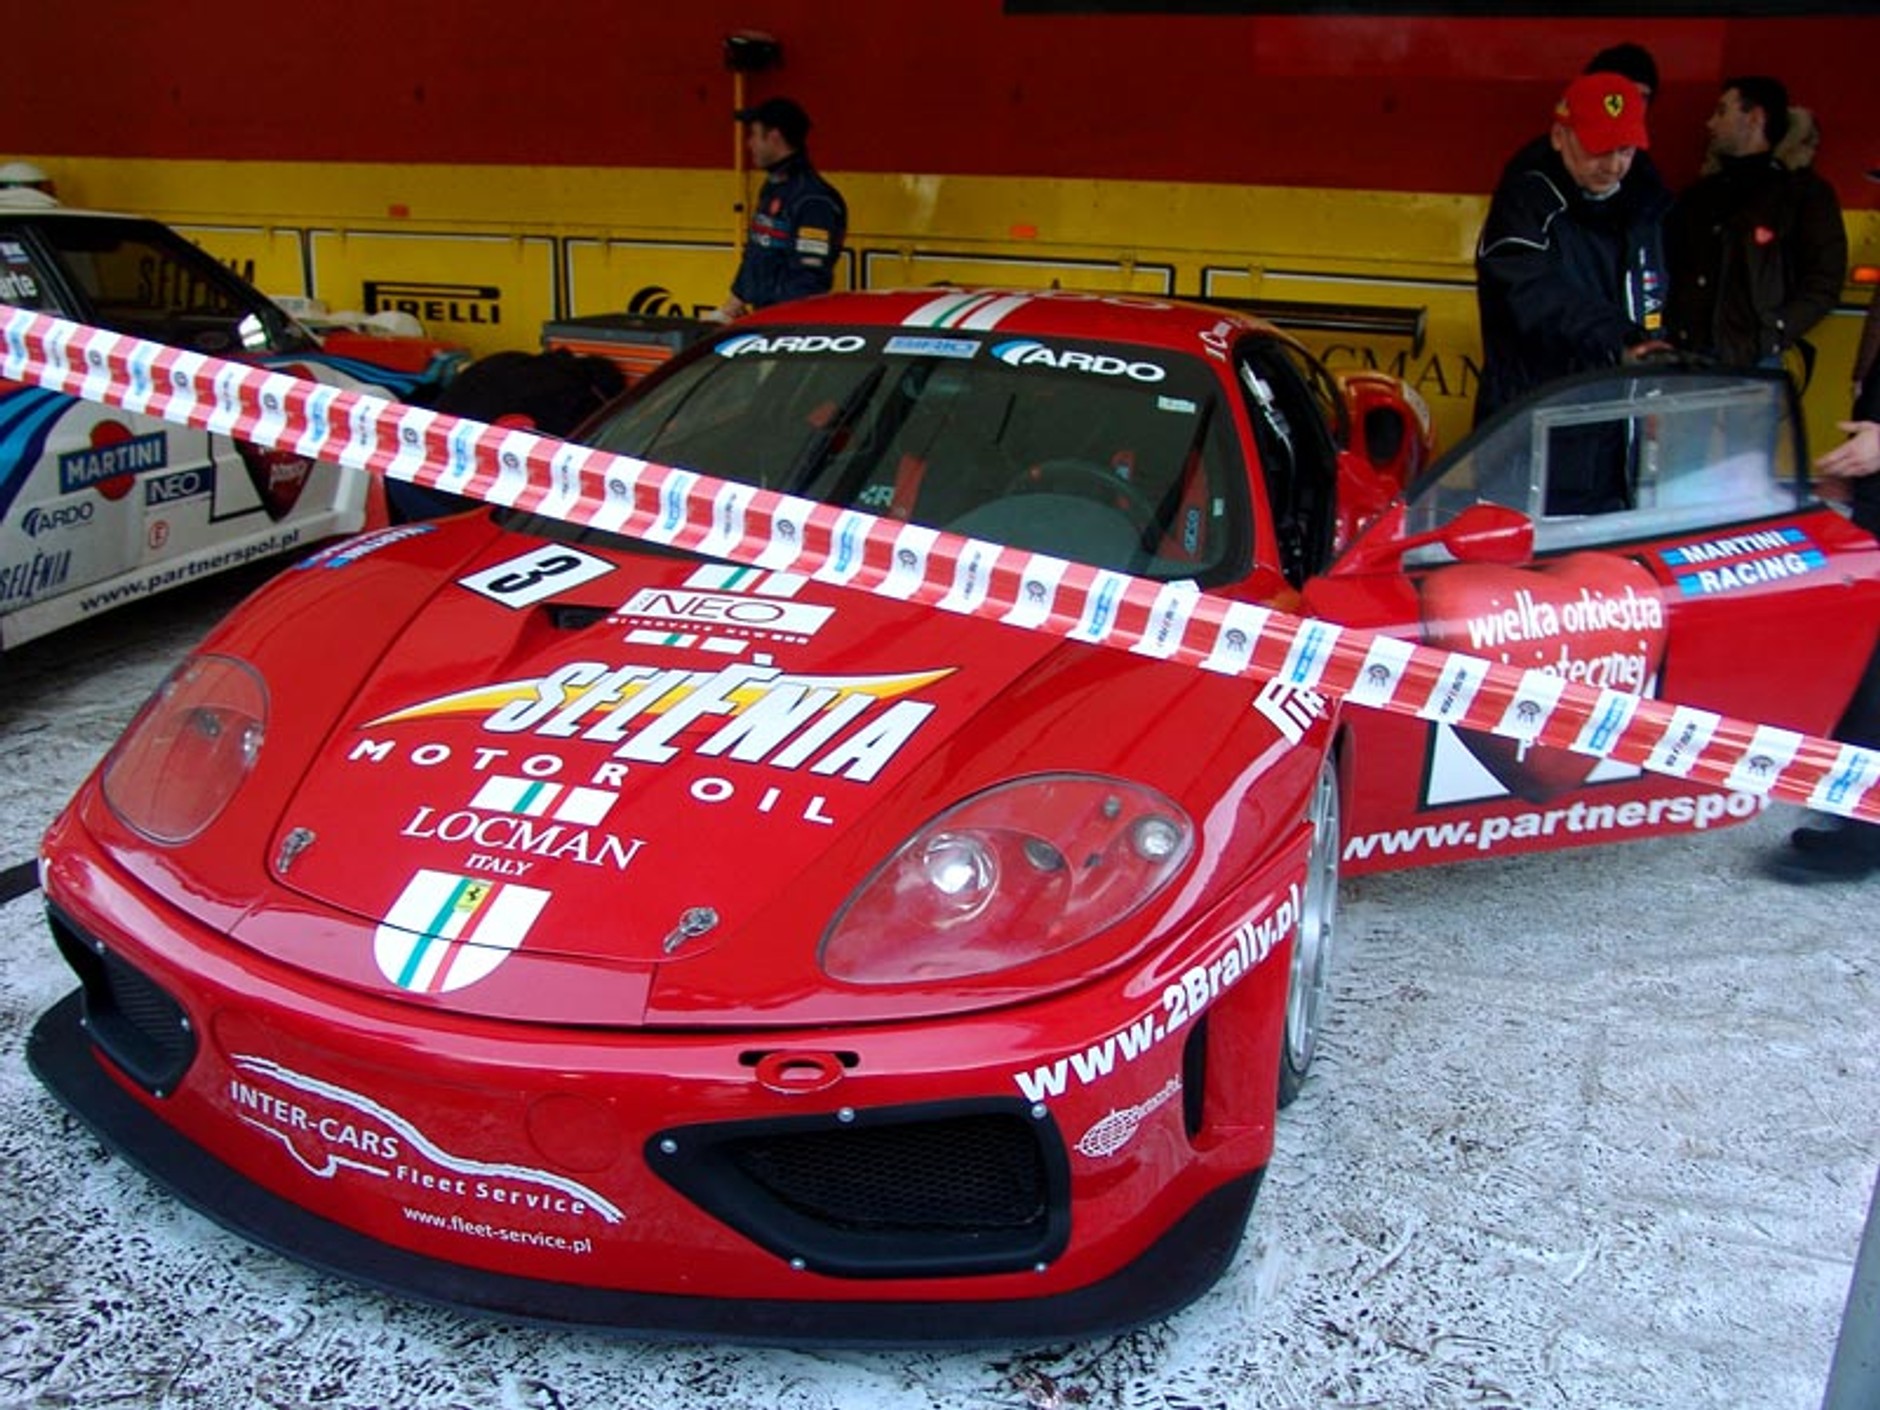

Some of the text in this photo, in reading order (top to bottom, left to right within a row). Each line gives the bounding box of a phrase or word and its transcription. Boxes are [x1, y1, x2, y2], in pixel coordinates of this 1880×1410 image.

[363, 281, 500, 323] PIRELLI
[738, 335, 867, 355] ARDO
[1021, 348, 1166, 382] ARDO
[66, 439, 164, 485] MARTINI
[149, 471, 200, 500] NEO
[37, 500, 94, 533] ARDO
[1678, 530, 1790, 563] MARTINI
[80, 529, 300, 612] www.partnerspol.pl
[487, 554, 582, 594] 3
[1697, 551, 1810, 594] RACING
[641, 593, 786, 624] NEO
[1468, 585, 1664, 650] wielka orkiestra
[347, 738, 835, 825] MOTOR OIL
[401, 806, 647, 870] LOCMAN
[464, 853, 534, 876] ITALY
[1014, 883, 1300, 1104] www.2Brally.pl
[230, 1079, 399, 1160] INTER-CARS
[396, 1164, 587, 1216] Fleet Service
[402, 1204, 593, 1254] www.fleet-service.pl
